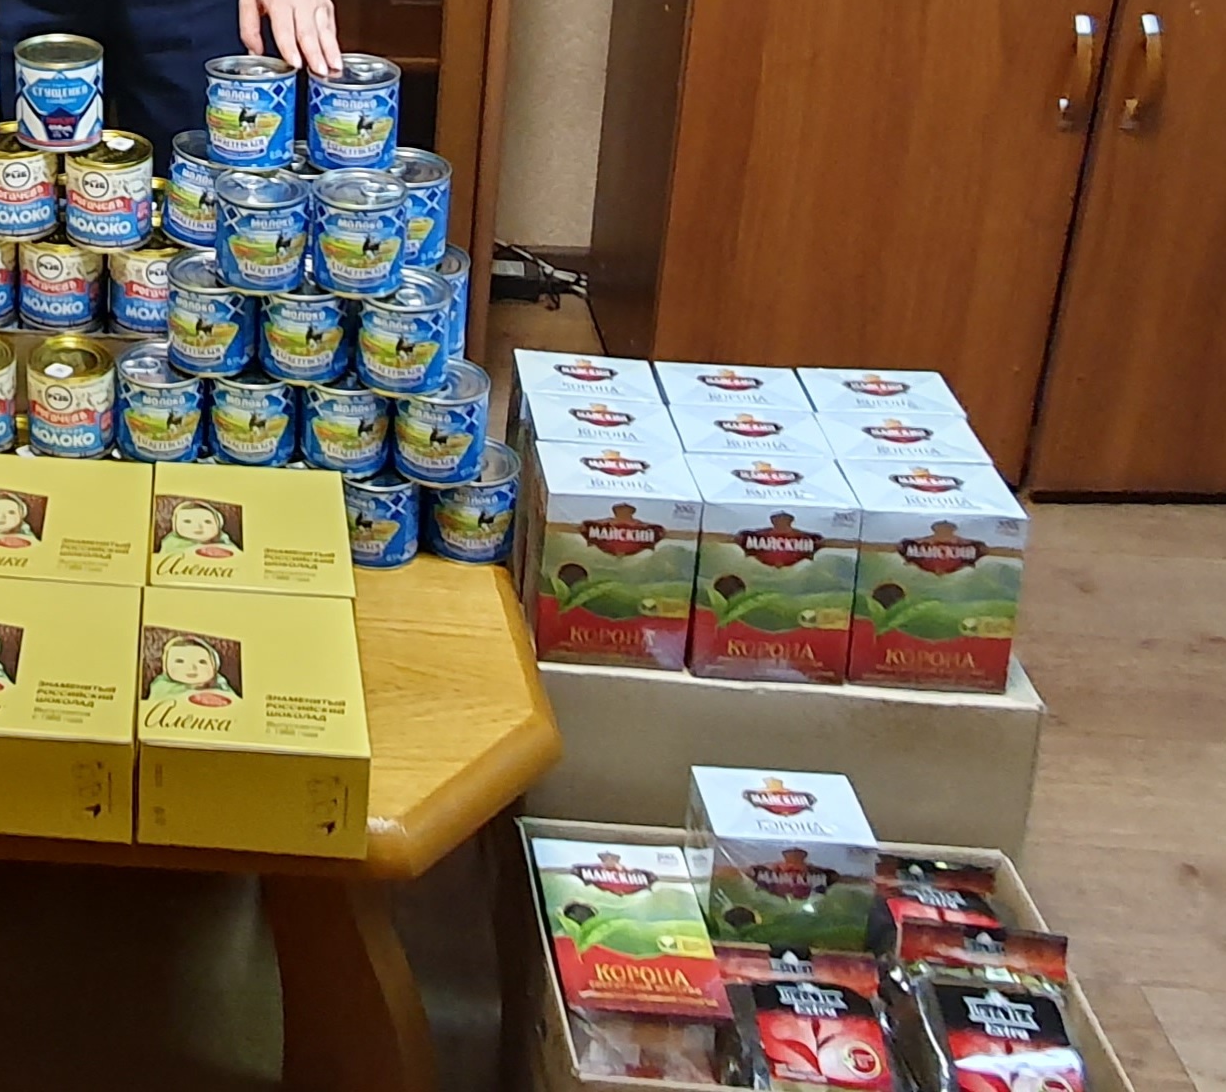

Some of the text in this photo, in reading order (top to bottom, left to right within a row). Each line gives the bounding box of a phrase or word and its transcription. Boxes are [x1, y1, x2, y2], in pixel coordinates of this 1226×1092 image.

[68, 214, 132, 236] МОЛОКО
[24, 296, 84, 314] МОЛОКО
[32, 426, 96, 448] МОЛОКО
[588, 526, 656, 542] МАЙСКИЙ
[746, 536, 814, 552] МАЙСКИЙ
[906, 544, 976, 560] МАЙСКИЙ
[570, 626, 656, 646] КОРОНА
[728, 640, 816, 662] КОРОНА
[884, 648, 976, 668] КОРОНА
[34, 696, 96, 708] ШОКОЛАД
[266, 694, 346, 708] ЗНАМЕНИТЫЙ
[266, 702, 346, 716] РОССИЙСКИЙ
[266, 710, 328, 722] ШОКОЛАД
[580, 868, 648, 886] МАЙСКИЙ
[594, 962, 690, 992] КОРОНА
